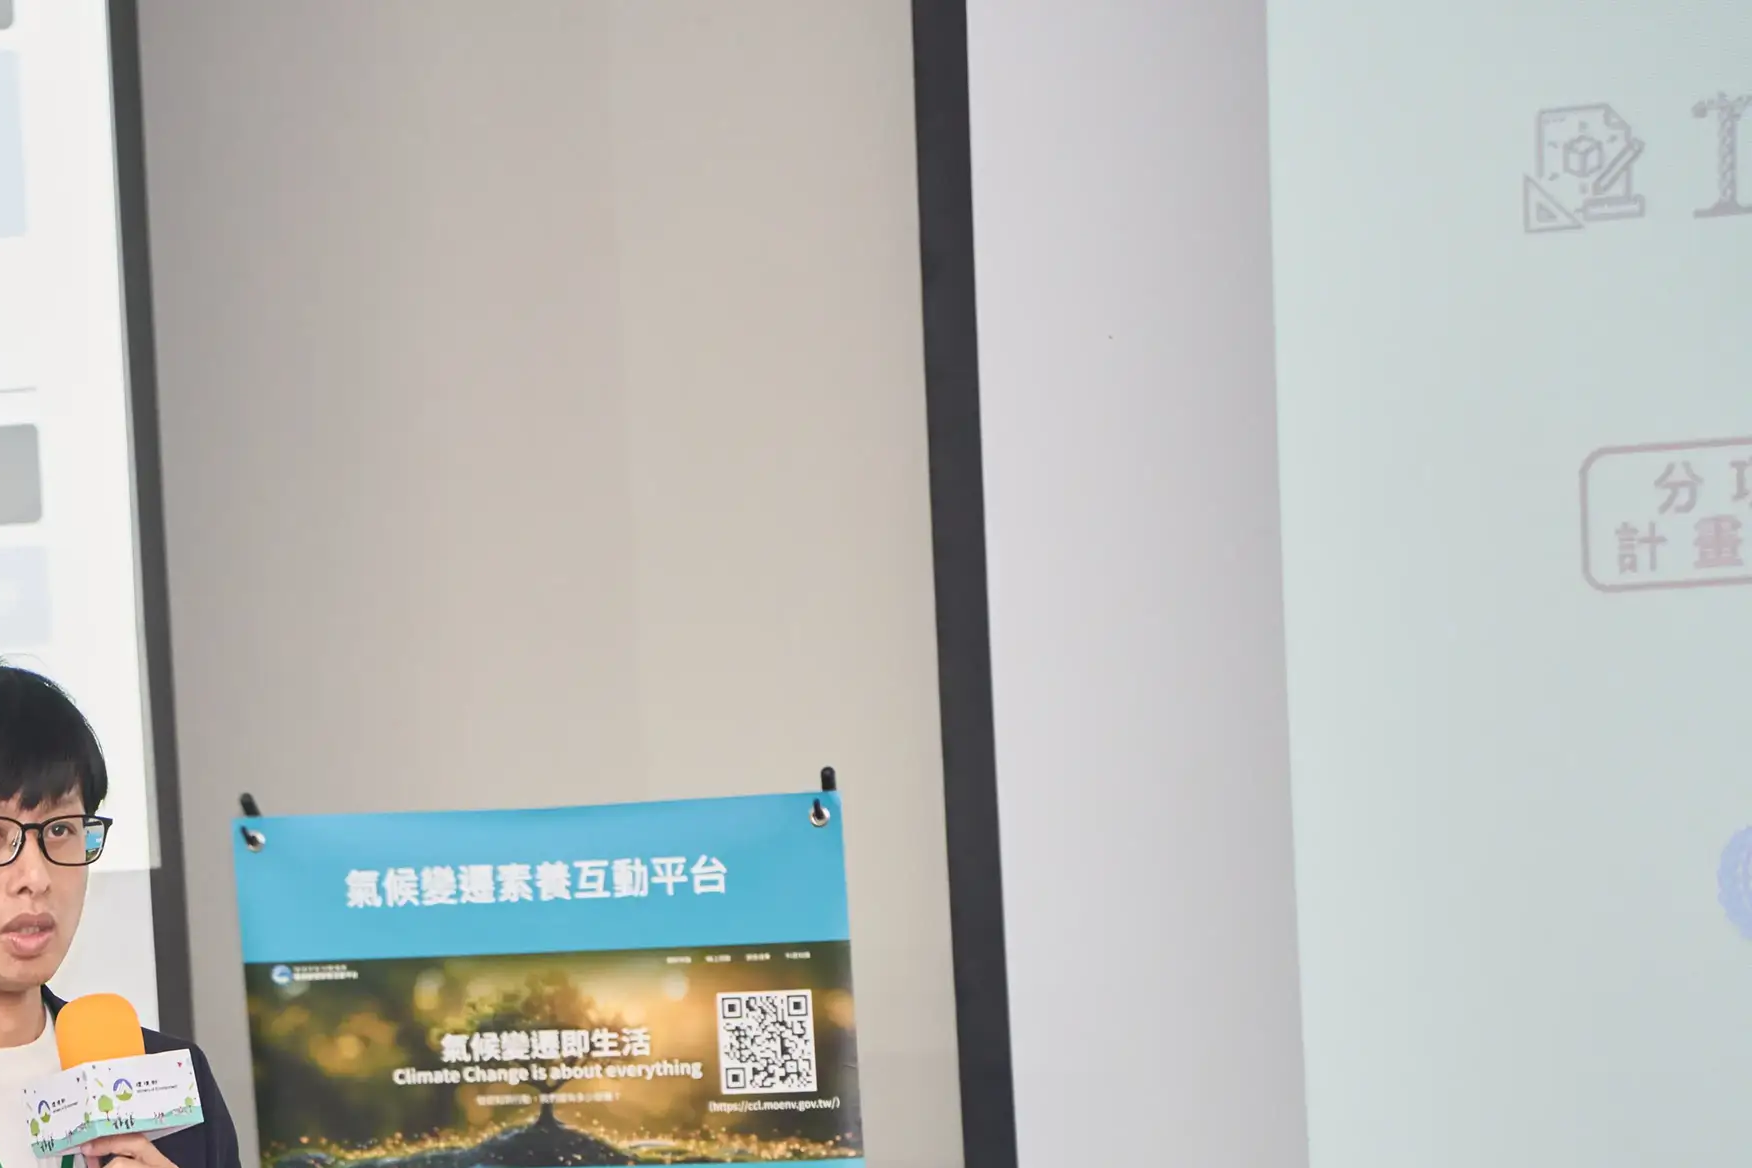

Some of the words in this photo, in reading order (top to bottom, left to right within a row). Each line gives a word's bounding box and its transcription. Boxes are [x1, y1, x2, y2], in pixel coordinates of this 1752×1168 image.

[1614, 515, 1745, 574] 計畫
[345, 854, 728, 909] 氣候變遷素養互動平台
[440, 1027, 652, 1063] 氣候變遷即生活
[392, 1066, 461, 1086] Climate
[462, 1065, 529, 1086] Change
[530, 1062, 548, 1081] is
[549, 1061, 603, 1081] about
[605, 1058, 704, 1081] everything
